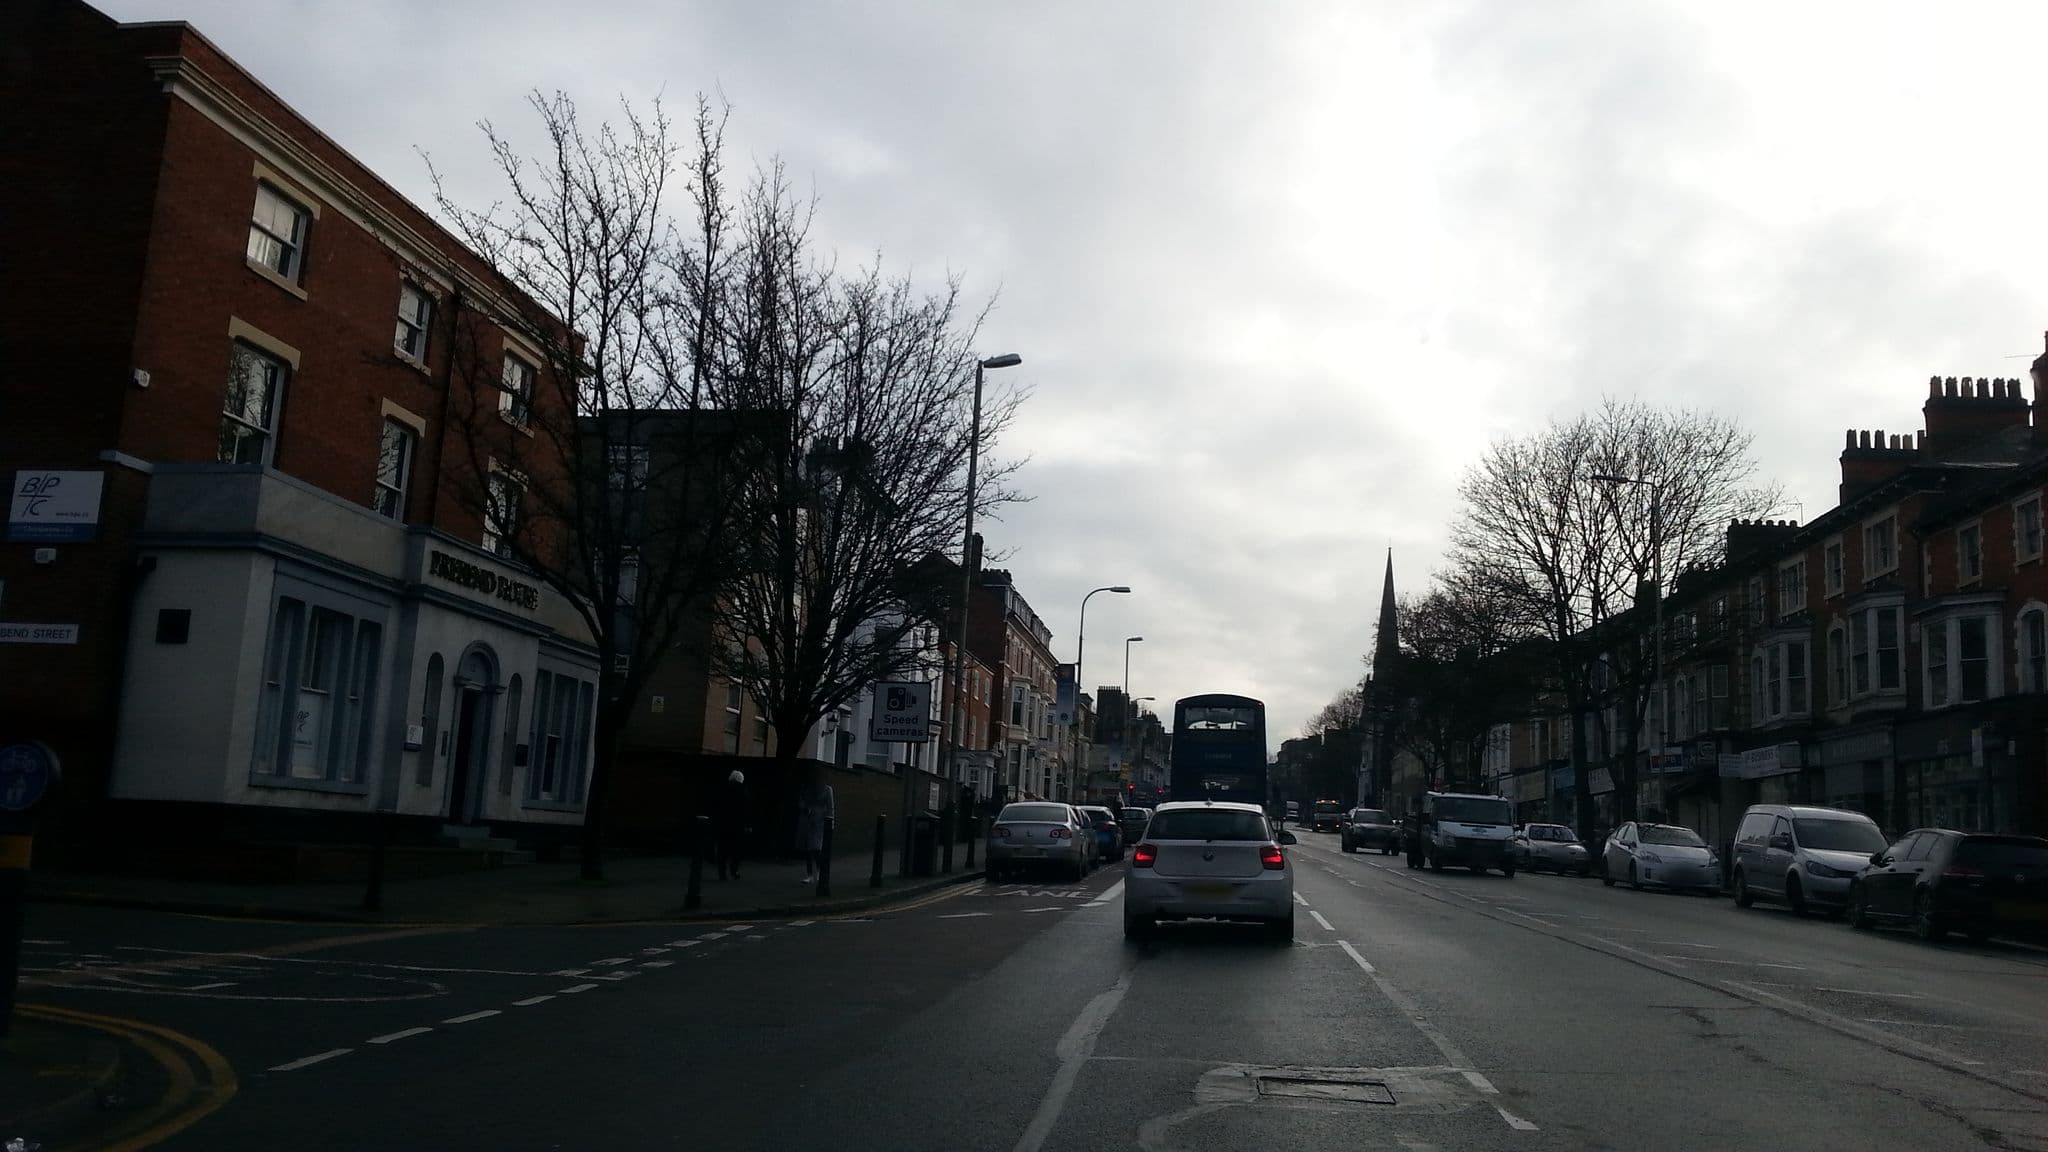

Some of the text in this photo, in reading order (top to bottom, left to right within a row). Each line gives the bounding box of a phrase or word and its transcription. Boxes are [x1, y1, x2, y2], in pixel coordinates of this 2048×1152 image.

[33, 629, 72, 639] STREET
[884, 714, 919, 725] Speed
[877, 728, 924, 737] cameras
